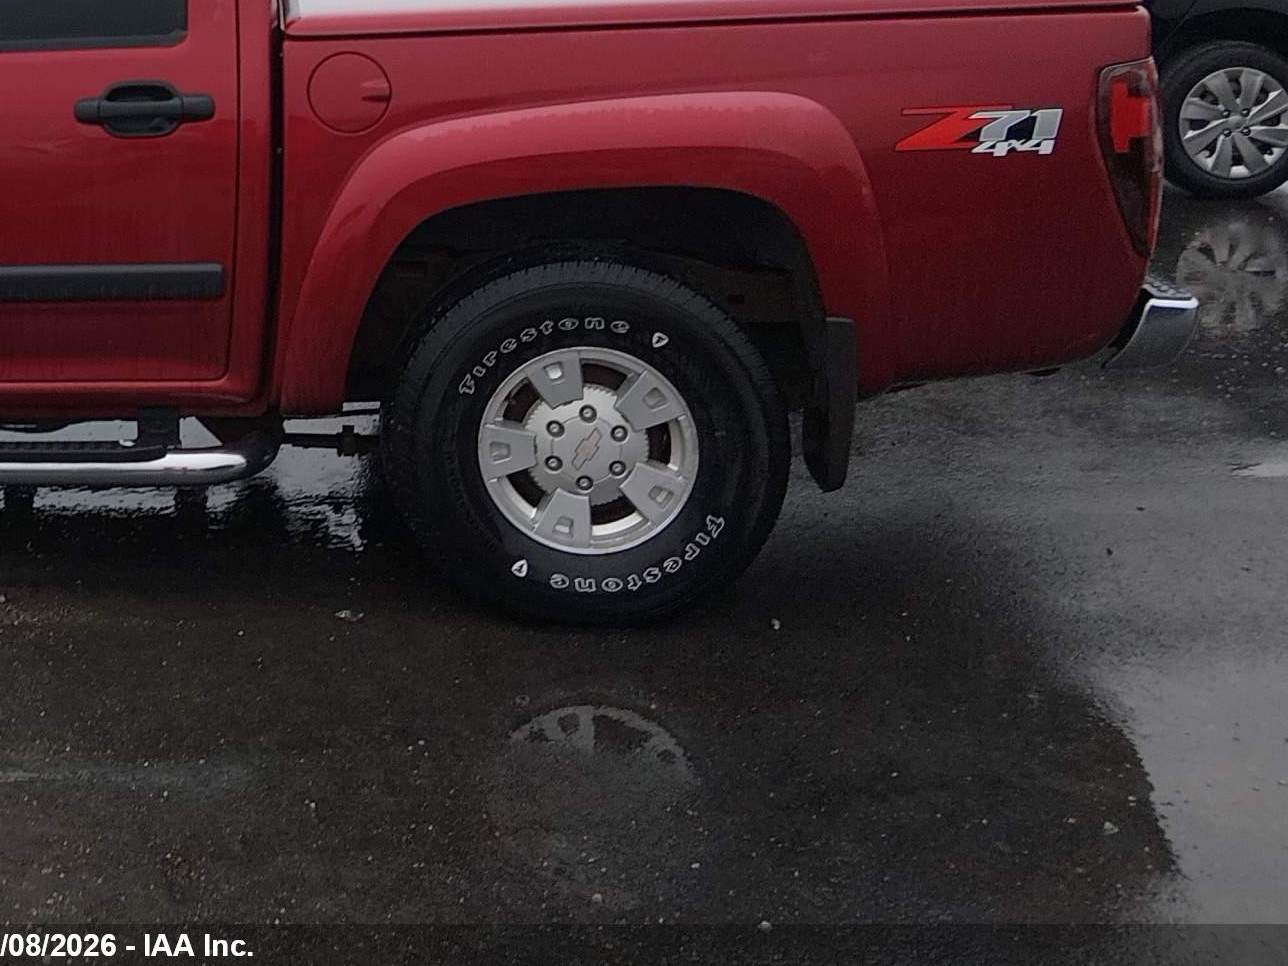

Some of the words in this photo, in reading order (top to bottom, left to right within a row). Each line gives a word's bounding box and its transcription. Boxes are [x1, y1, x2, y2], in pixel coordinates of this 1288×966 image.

[894, 105, 1063, 151] Z71
[459, 316, 630, 396] Firestone
[549, 514, 726, 594] Firestone
